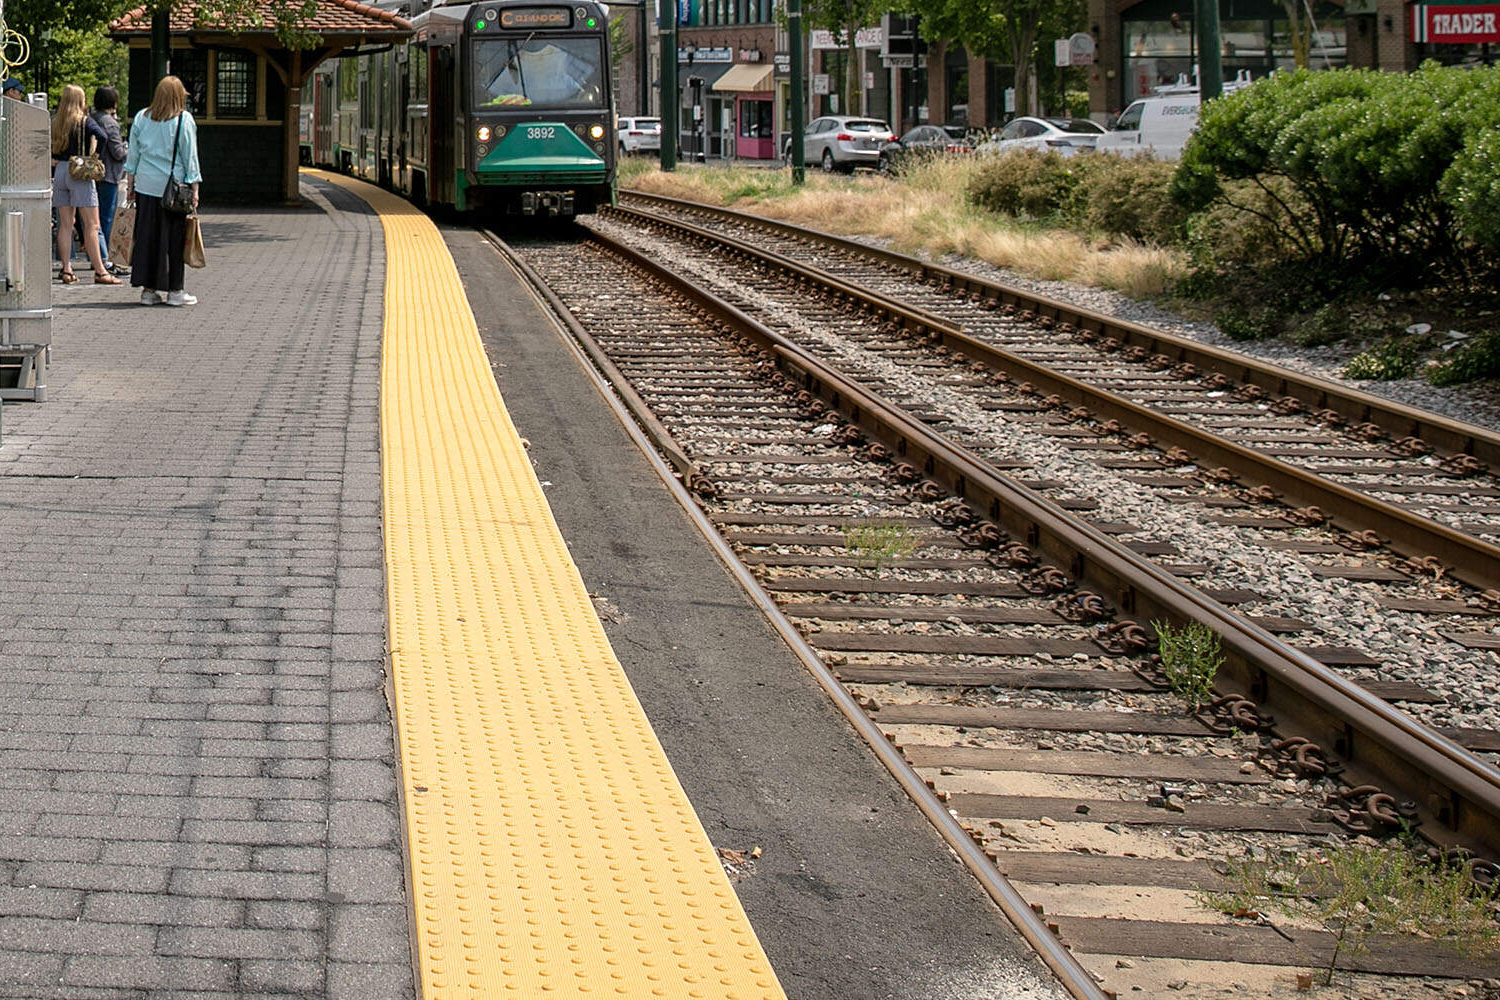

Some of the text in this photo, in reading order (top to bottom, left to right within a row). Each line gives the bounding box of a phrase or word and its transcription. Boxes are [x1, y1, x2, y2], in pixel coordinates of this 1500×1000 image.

[501, 12, 513, 25] C
[1432, 13, 1497, 35] TRADER
[527, 127, 555, 139] 3892
